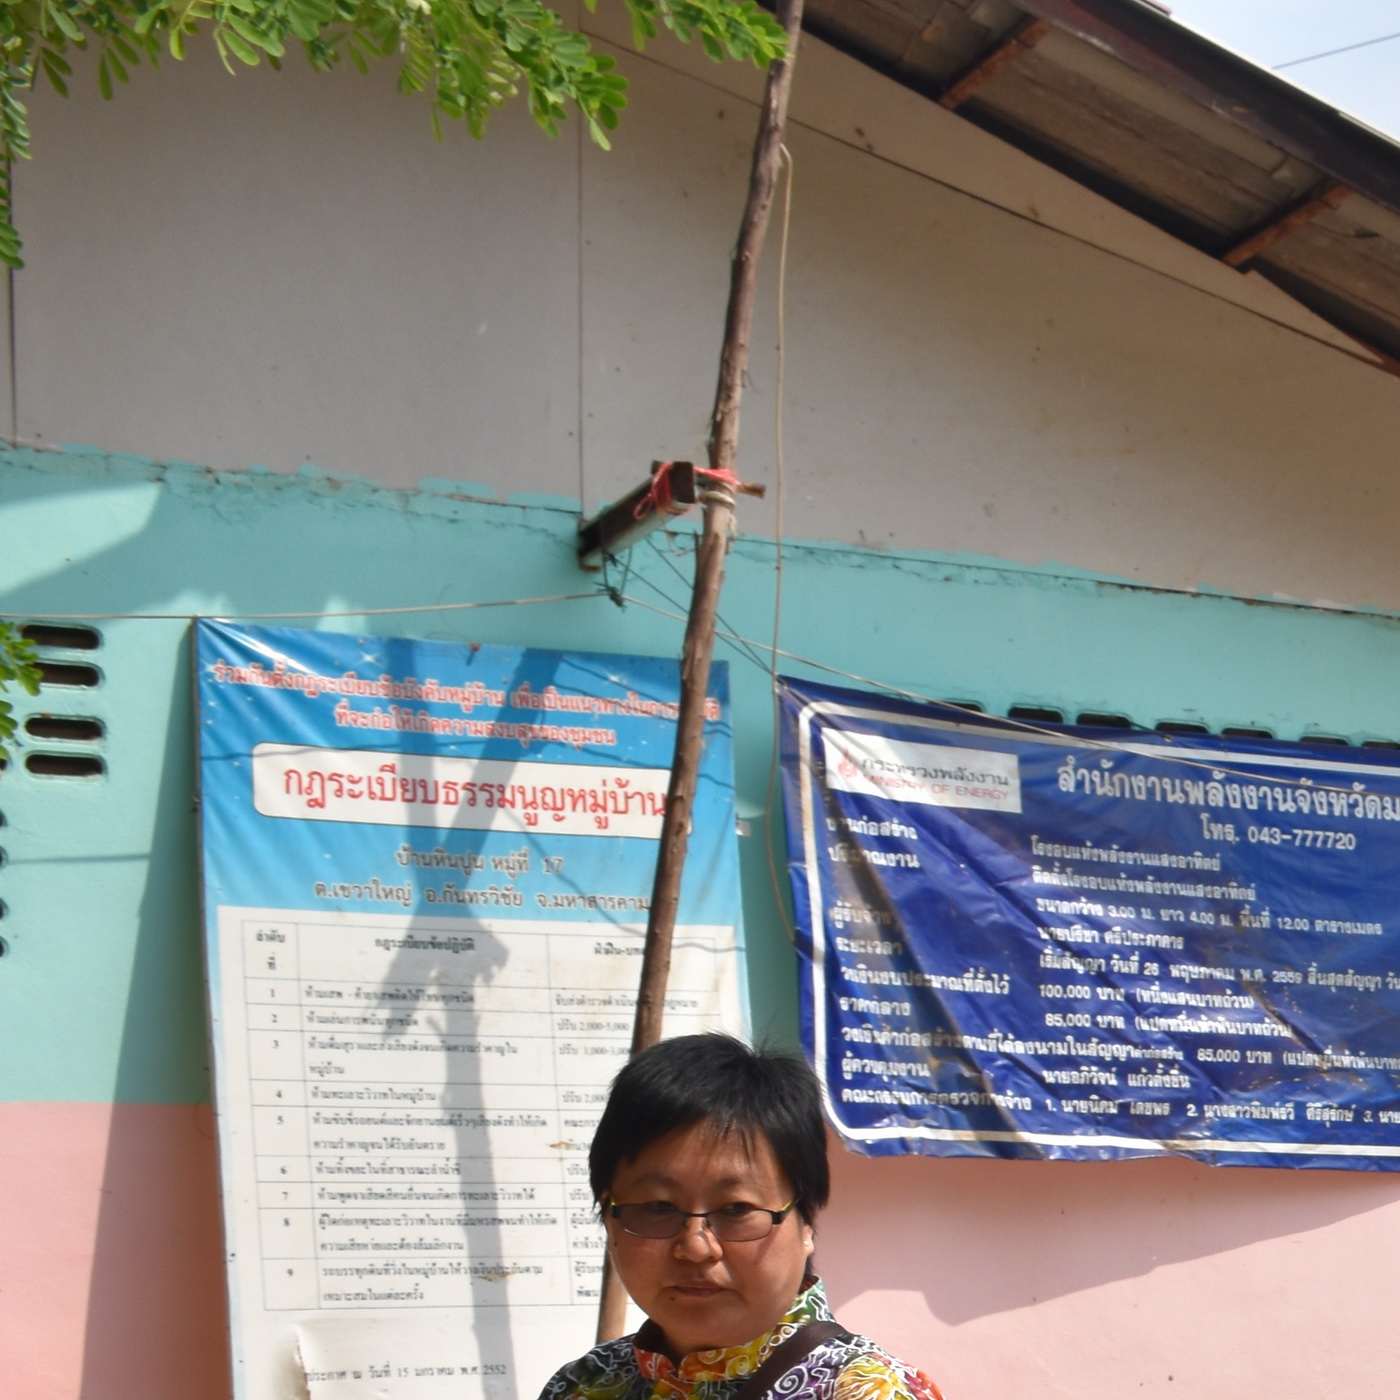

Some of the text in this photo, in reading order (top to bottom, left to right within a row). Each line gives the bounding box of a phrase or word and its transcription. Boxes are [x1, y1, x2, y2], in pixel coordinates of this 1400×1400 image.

[862, 757, 1010, 786] กระทรวงพลังงาน
[284, 763, 667, 829] กฎระเบียบธรรมนูญหมู่บ้าน
[932, 783, 950, 795] OF
[955, 785, 1010, 800] ENERGY
[826, 814, 919, 840] งนก่อสร้าง
[1248, 825, 1356, 850] 043-777720
[542, 855, 563, 874] 17
[828, 842, 921, 868] ปริาณงาน
[1108, 904, 1135, 919] 3.00
[1190, 911, 1215, 925] 4.00
[1277, 917, 1309, 931] 12.00
[1272, 969, 1302, 984] 2559
